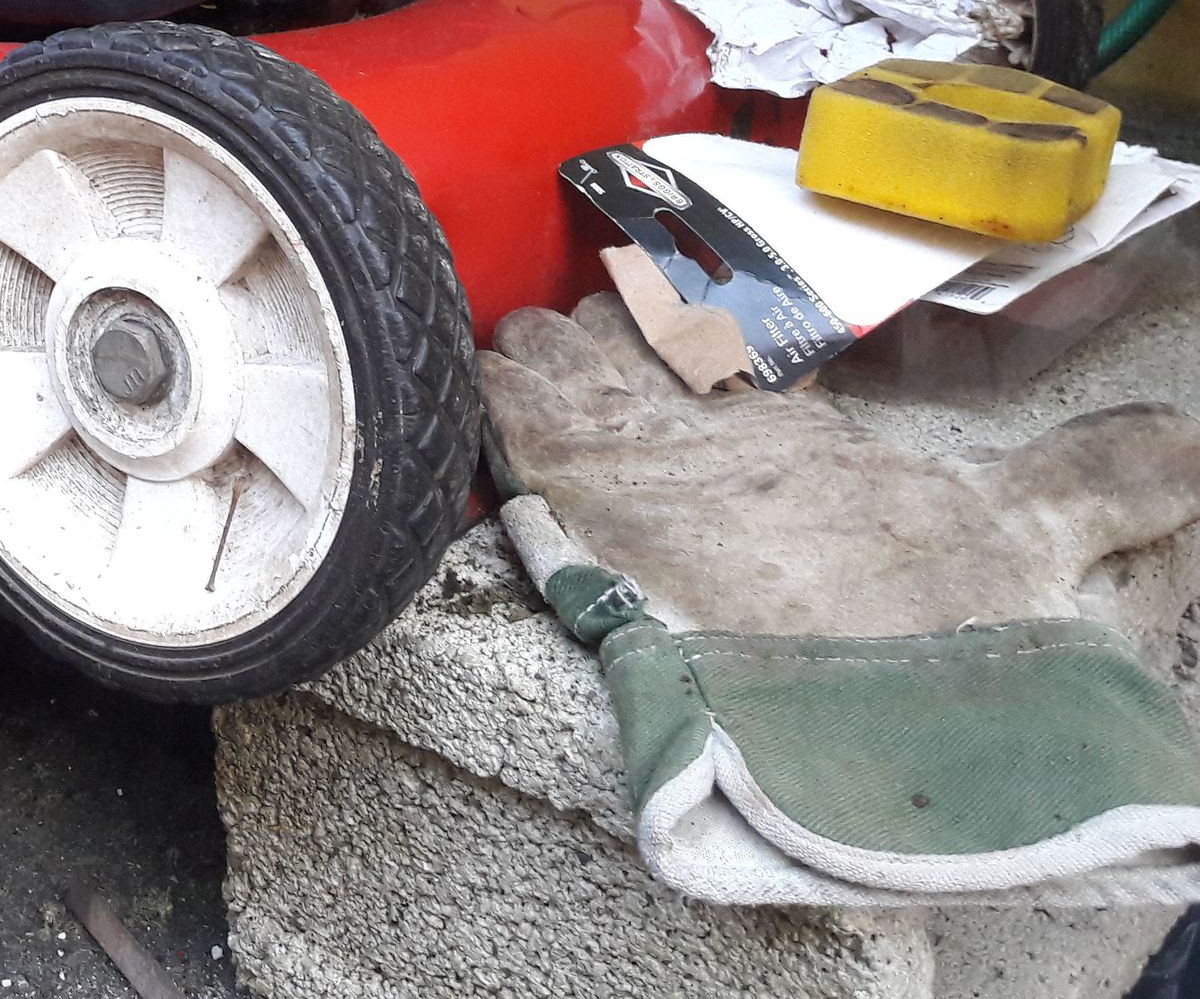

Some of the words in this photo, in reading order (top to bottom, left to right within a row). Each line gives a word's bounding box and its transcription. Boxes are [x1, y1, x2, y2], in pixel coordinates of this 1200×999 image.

[616, 154, 651, 178] STRATTON
[653, 181, 684, 205] BRIGGS
[743, 227, 766, 247] Gross
[762, 246, 791, 271] 3.0-5.0
[772, 286, 794, 309] Aire
[770, 305, 787, 320] Air
[760, 317, 788, 348] Filter
[792, 329, 815, 357] Filtre
[802, 320, 826, 349] Filtro
[745, 345, 777, 383] 698369
[785, 346, 804, 364] Air
